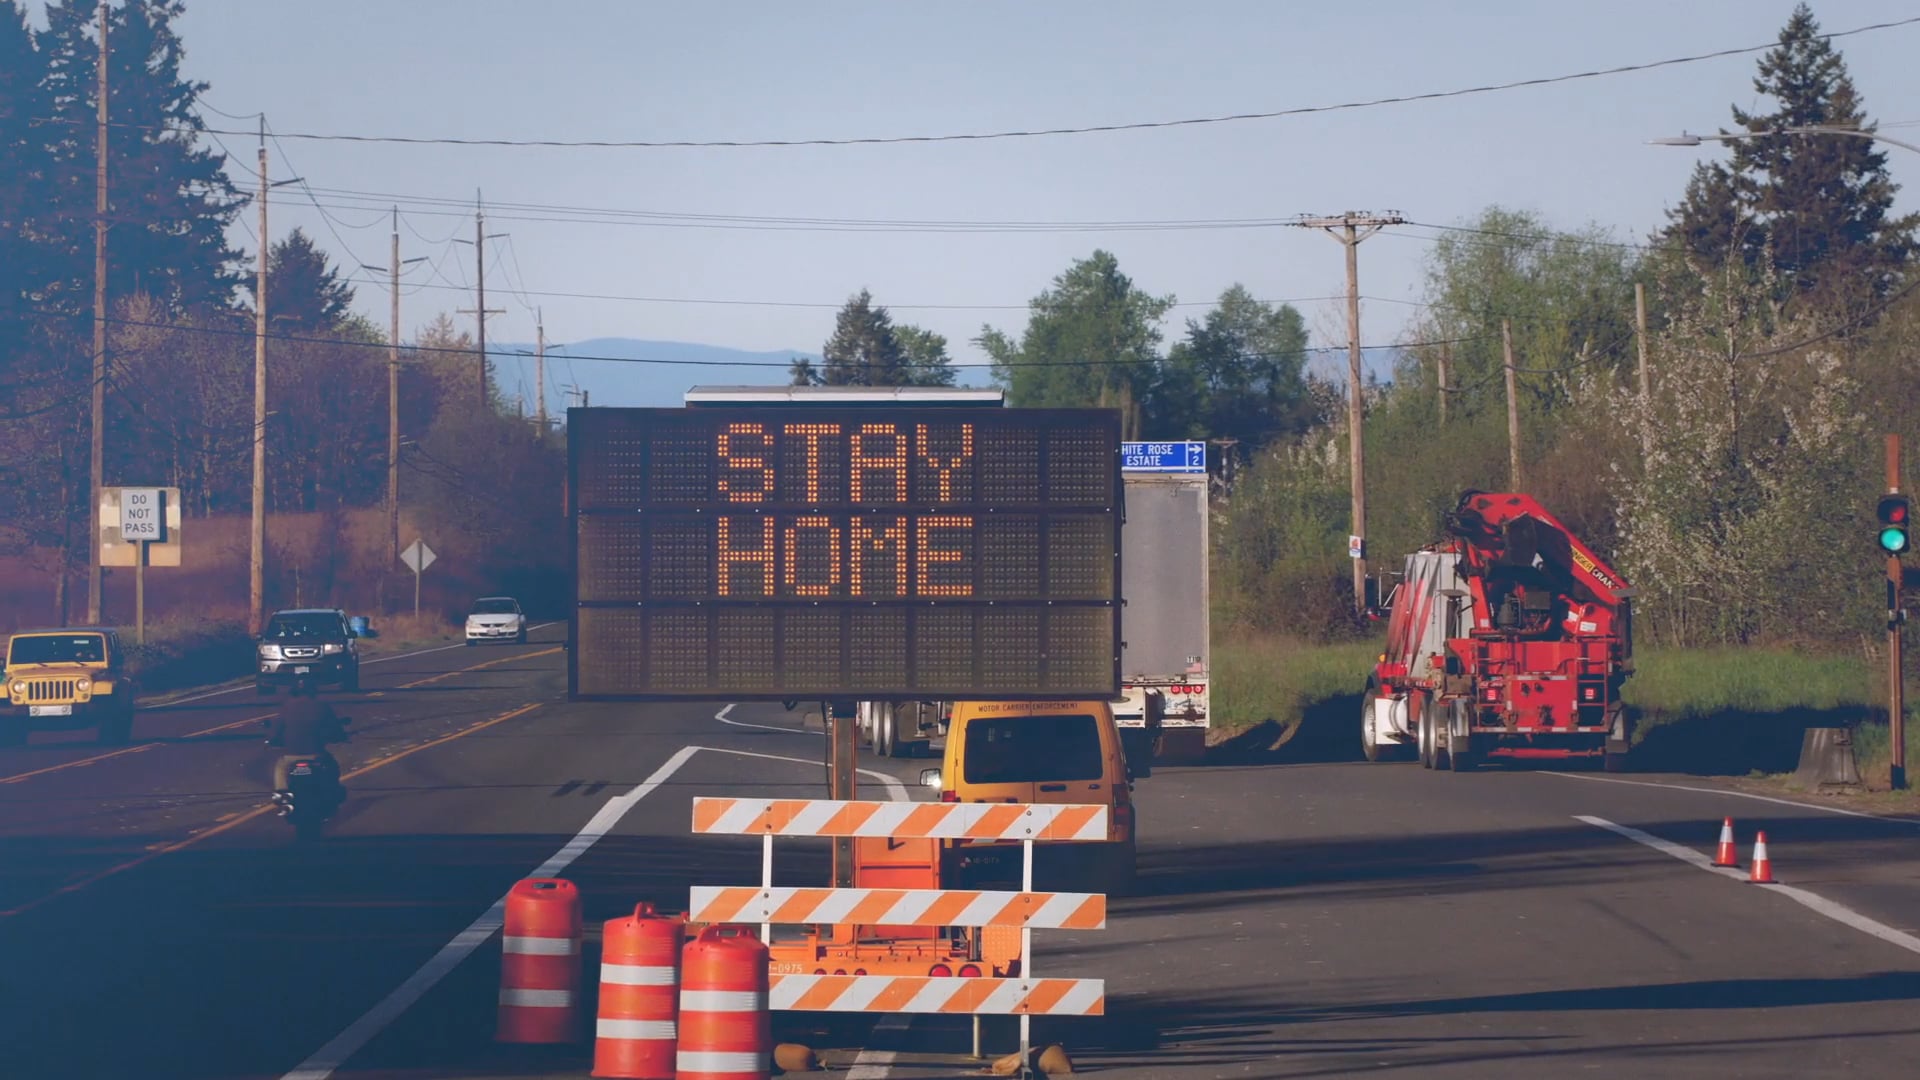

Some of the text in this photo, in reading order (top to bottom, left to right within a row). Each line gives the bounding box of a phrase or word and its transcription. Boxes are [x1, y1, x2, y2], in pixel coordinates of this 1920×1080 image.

[1121, 445, 1173, 455] HITE ROSE
[718, 424, 973, 502] STAY
[1126, 456, 1161, 466] ESTATE
[1193, 456, 1200, 466] 2
[132, 495, 147, 505] DO
[128, 509, 151, 519] NOT
[125, 523, 154, 533] PASS
[718, 517, 973, 595] HOME
[978, 702, 1079, 713] MOTOR CARRIER ENFORCEMENT
[769, 962, 803, 974] -0975
